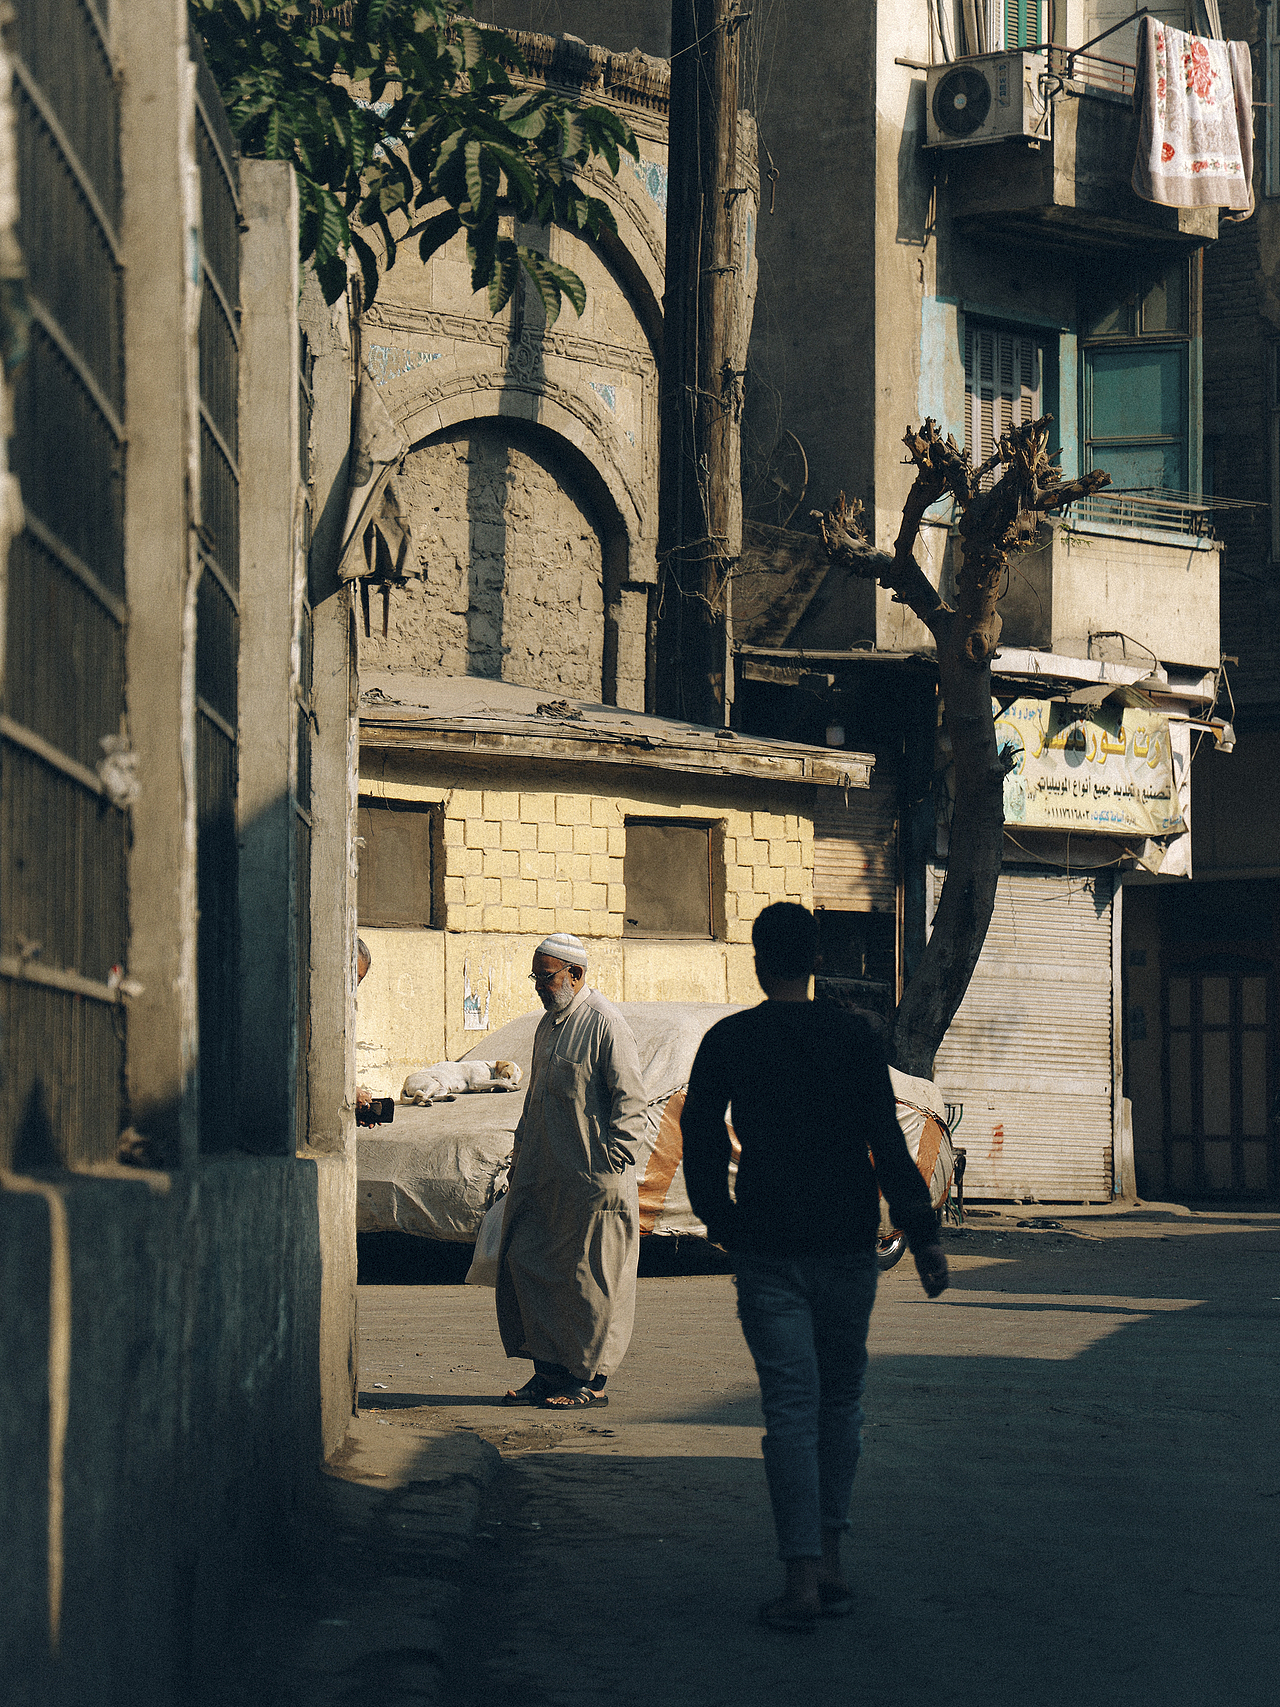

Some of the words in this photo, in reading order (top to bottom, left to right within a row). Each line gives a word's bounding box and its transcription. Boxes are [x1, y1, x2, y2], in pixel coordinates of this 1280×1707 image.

[1023, 707, 1036, 720] حول
[1072, 775, 1091, 797] أنواع
[1093, 783, 1111, 800] جميع
[1141, 785, 1171, 805] تصنيع
